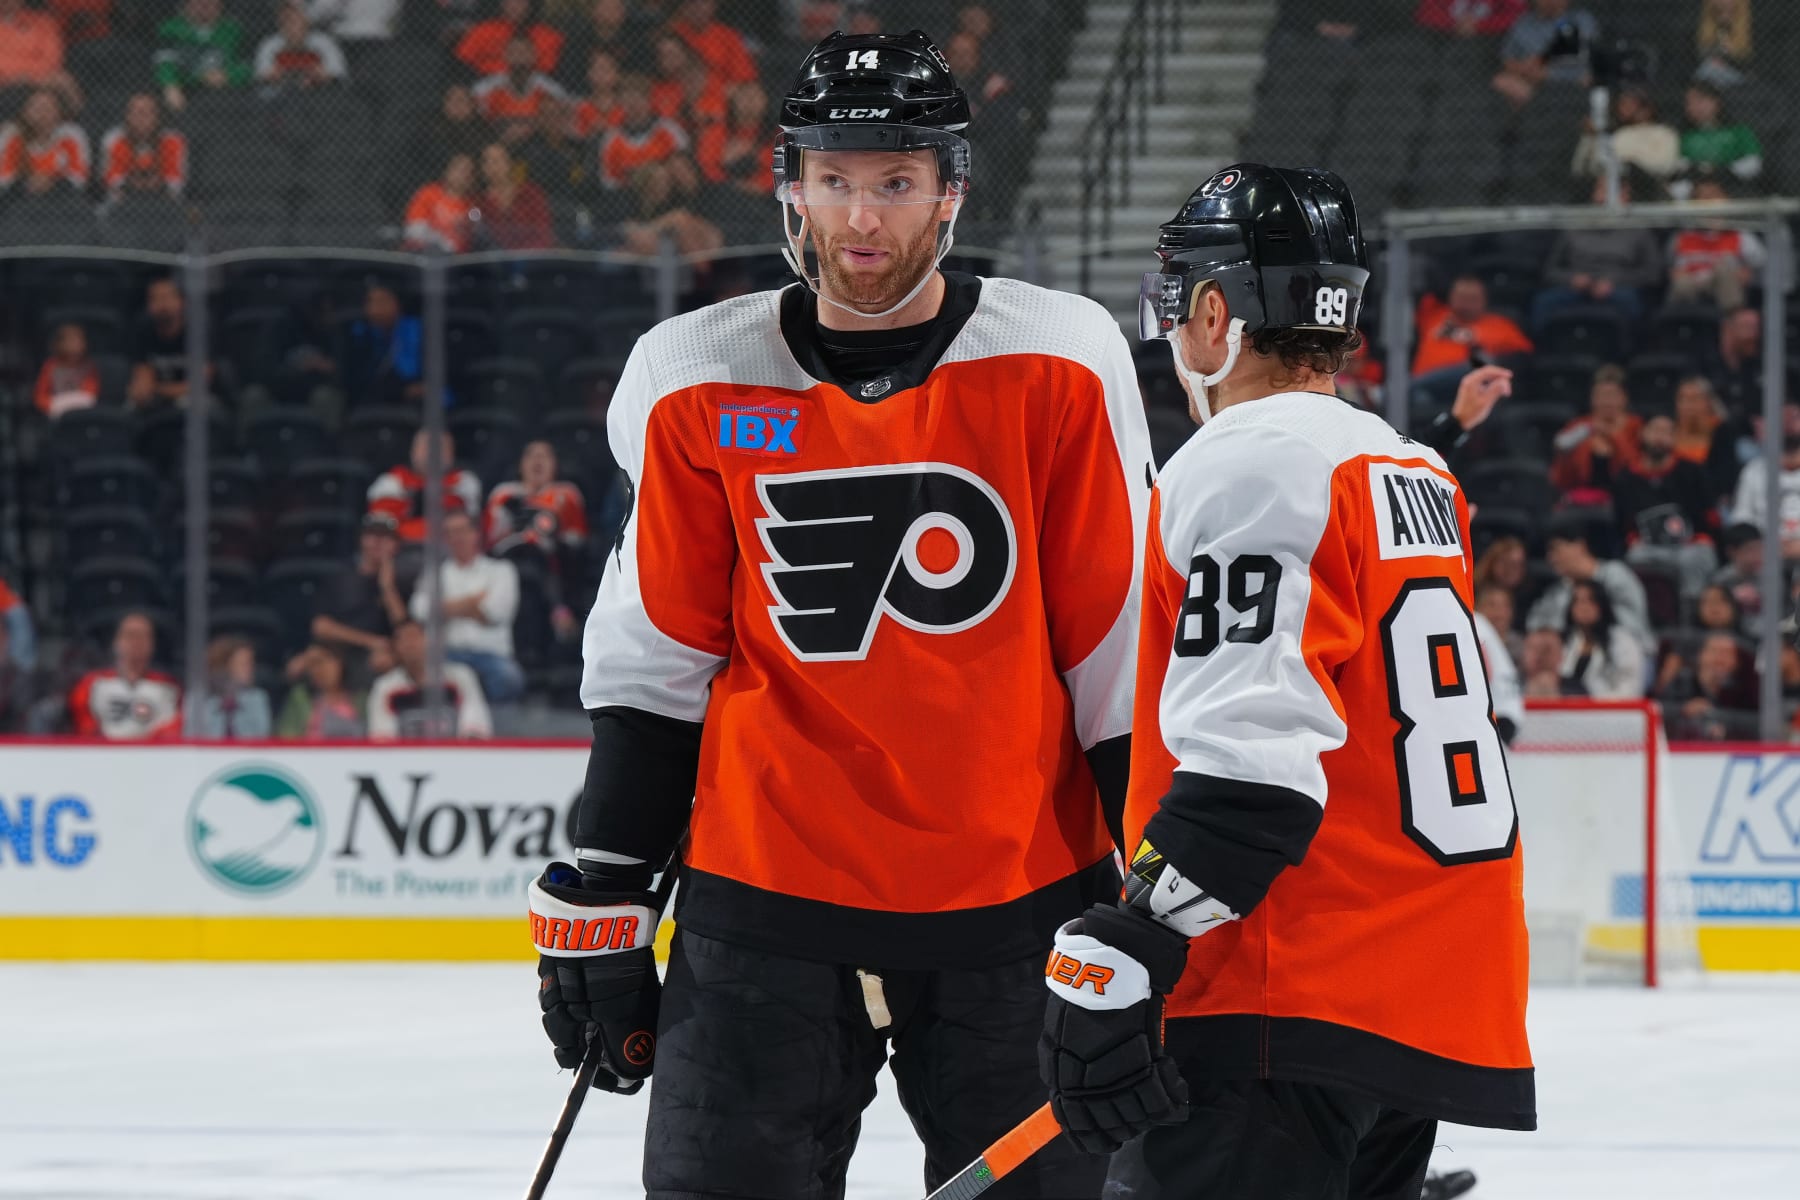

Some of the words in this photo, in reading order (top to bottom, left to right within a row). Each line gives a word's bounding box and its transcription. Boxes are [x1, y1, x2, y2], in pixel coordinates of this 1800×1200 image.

[845, 50, 879, 70] 14
[828, 108, 890, 119] CCM
[1315, 286, 1348, 326] 89
[719, 402, 787, 416] Independence
[719, 413, 799, 454] IBX
[1173, 553, 1282, 658] 89
[334, 868, 385, 896] The
[394, 868, 480, 896] Power
[486, 867, 517, 896] of
[528, 908, 639, 951] RRIOR
